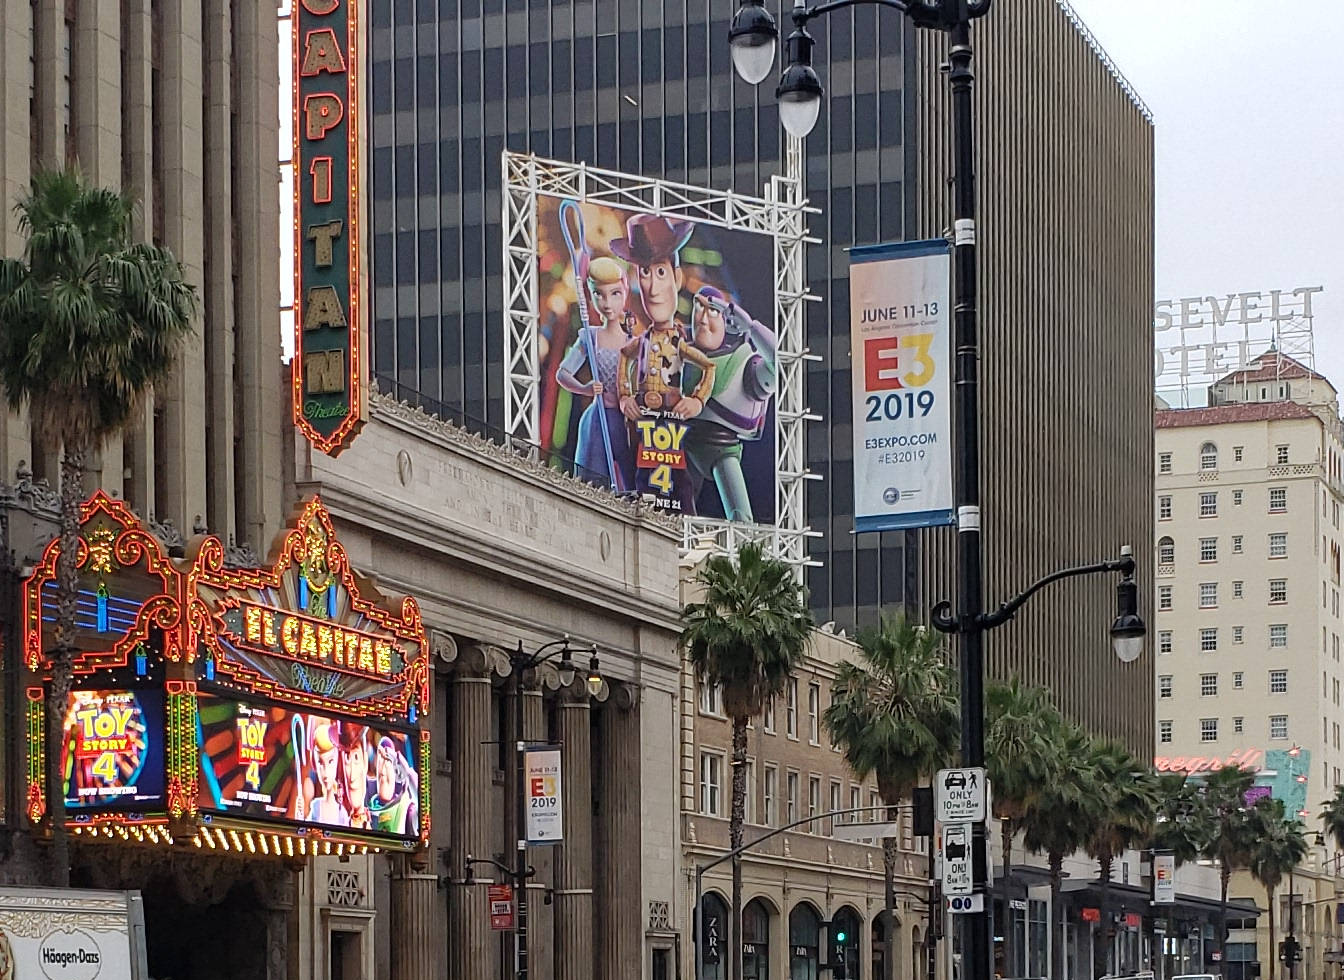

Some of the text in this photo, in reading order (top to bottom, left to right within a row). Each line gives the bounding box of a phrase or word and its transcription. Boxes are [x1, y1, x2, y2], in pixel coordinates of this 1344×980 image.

[300, 0, 347, 396] APITAN
[861, 302, 938, 323] JUNE 11-13
[1155, 286, 1323, 332] SEVELT
[864, 334, 936, 392] E3
[1155, 340, 1262, 377] OTEL
[303, 402, 350, 418] Theatre
[663, 411, 685, 420] PIXAR
[865, 390, 935, 422] 2019
[637, 421, 688, 451] TOY
[865, 433, 937, 450] E3EXPO.COM
[642, 451, 682, 465] STORY
[649, 464, 673, 494] 4
[245, 605, 393, 676] EL CAPITAN
[76, 709, 133, 739] TOY
[237, 718, 267, 748] TOY
[82, 739, 128, 752] STORY
[241, 749, 265, 762] STORY
[92, 751, 118, 782] 4
[245, 761, 260, 790] 4
[531, 777, 556, 797] E3
[950, 791, 973, 800] ONLY
[531, 798, 556, 808] 2019
[708, 917, 718, 956] ZARA
[43, 947, 99, 968] Häagen-Dazs
